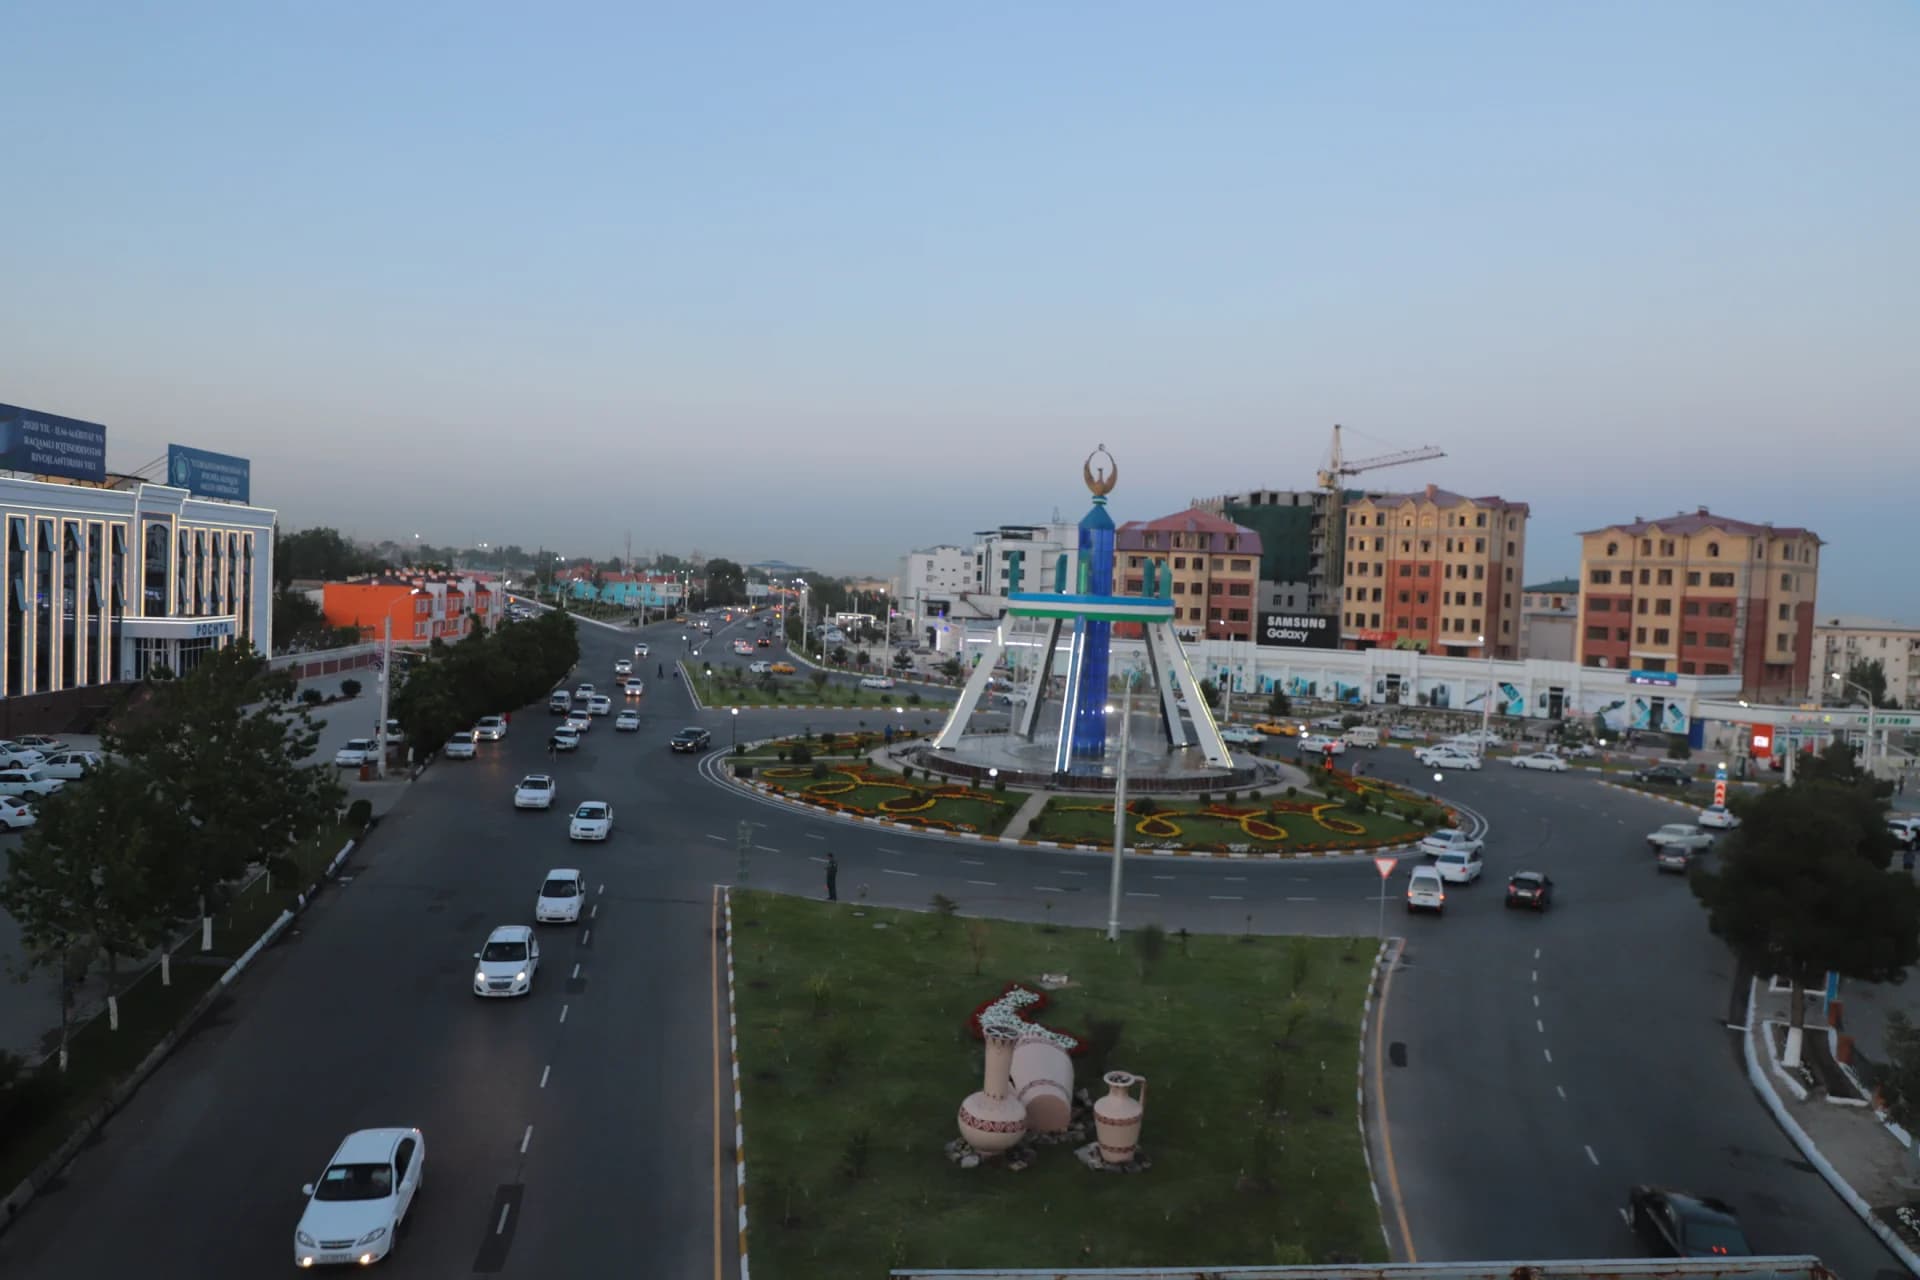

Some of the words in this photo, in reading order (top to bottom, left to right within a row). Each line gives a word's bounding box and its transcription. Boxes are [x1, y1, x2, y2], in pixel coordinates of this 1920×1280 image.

[196, 622, 229, 637] POCHTA
[1267, 615, 1327, 629] SAMSUNG
[1266, 627, 1309, 643] Galaxy
